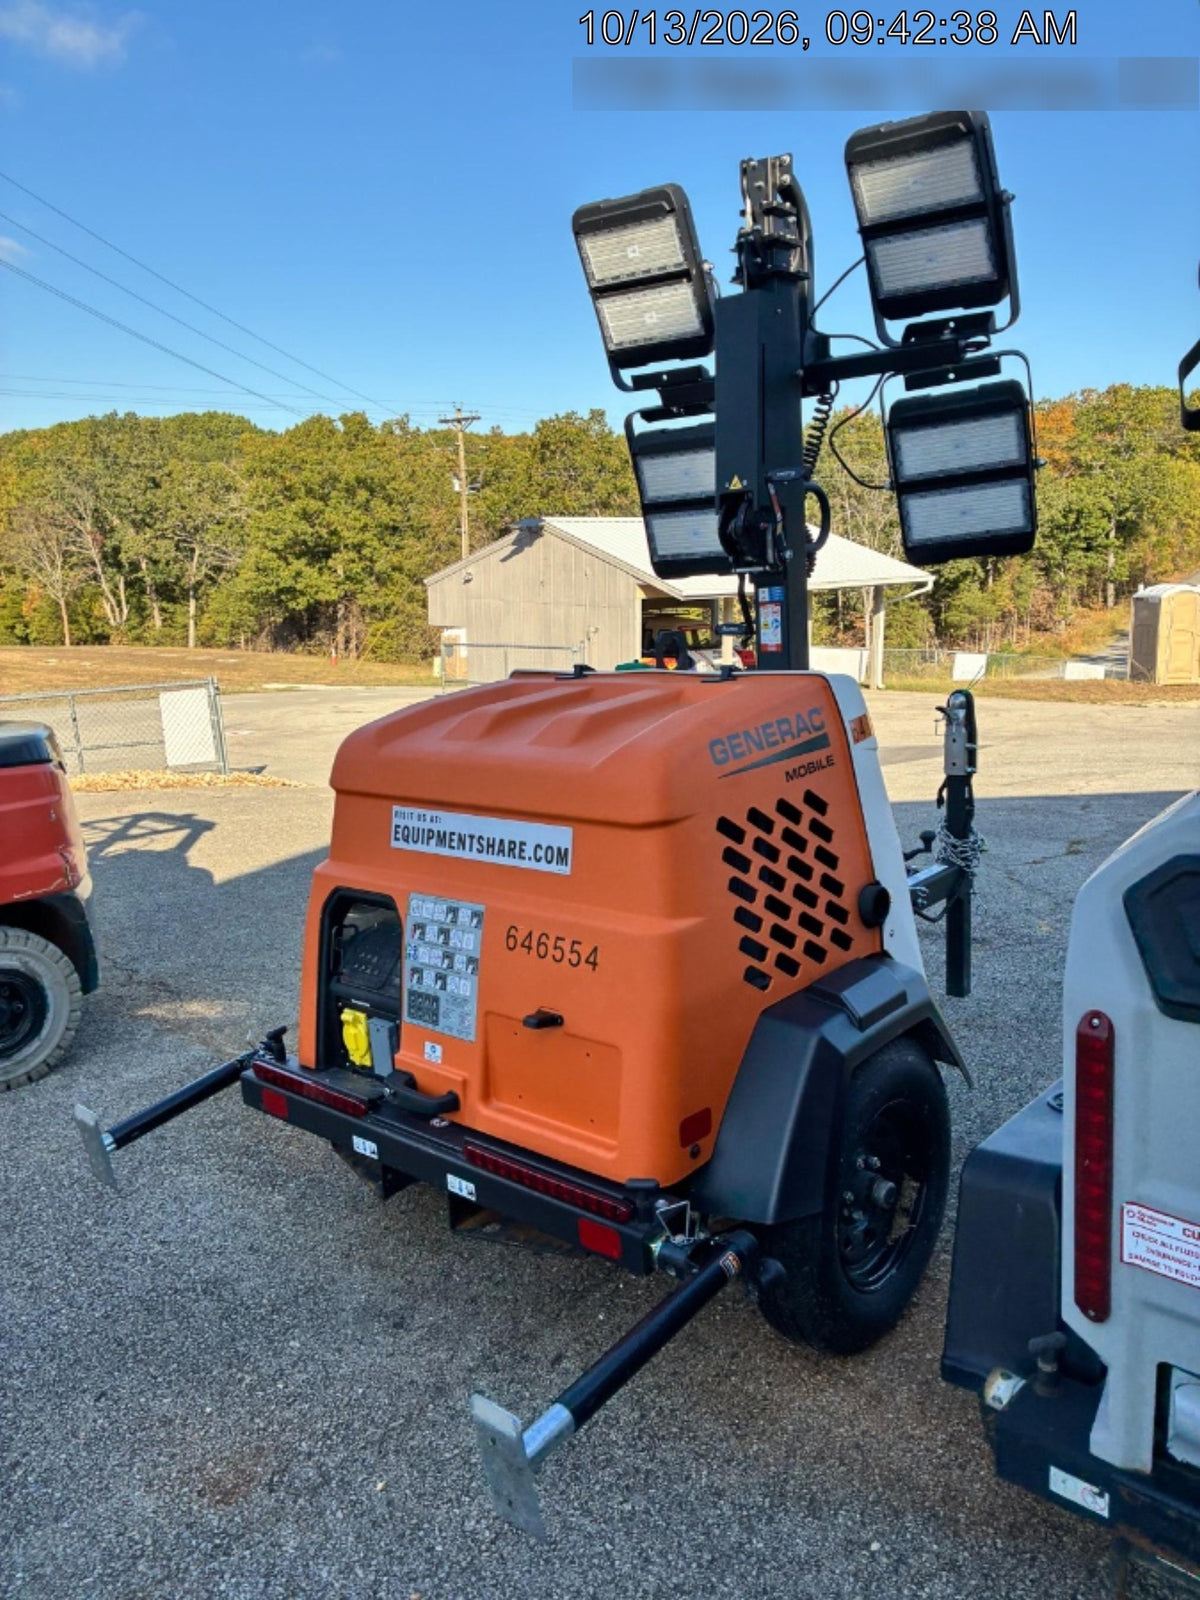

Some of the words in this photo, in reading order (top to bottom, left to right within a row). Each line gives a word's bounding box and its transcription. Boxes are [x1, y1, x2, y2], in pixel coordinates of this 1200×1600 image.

[708, 707, 826, 766] GENERAC
[785, 755, 836, 783] MOBILE
[417, 813, 427, 822] US
[393, 824, 569, 867] EQUIPMENTSHARE.COM
[506, 925, 599, 972] 646554
